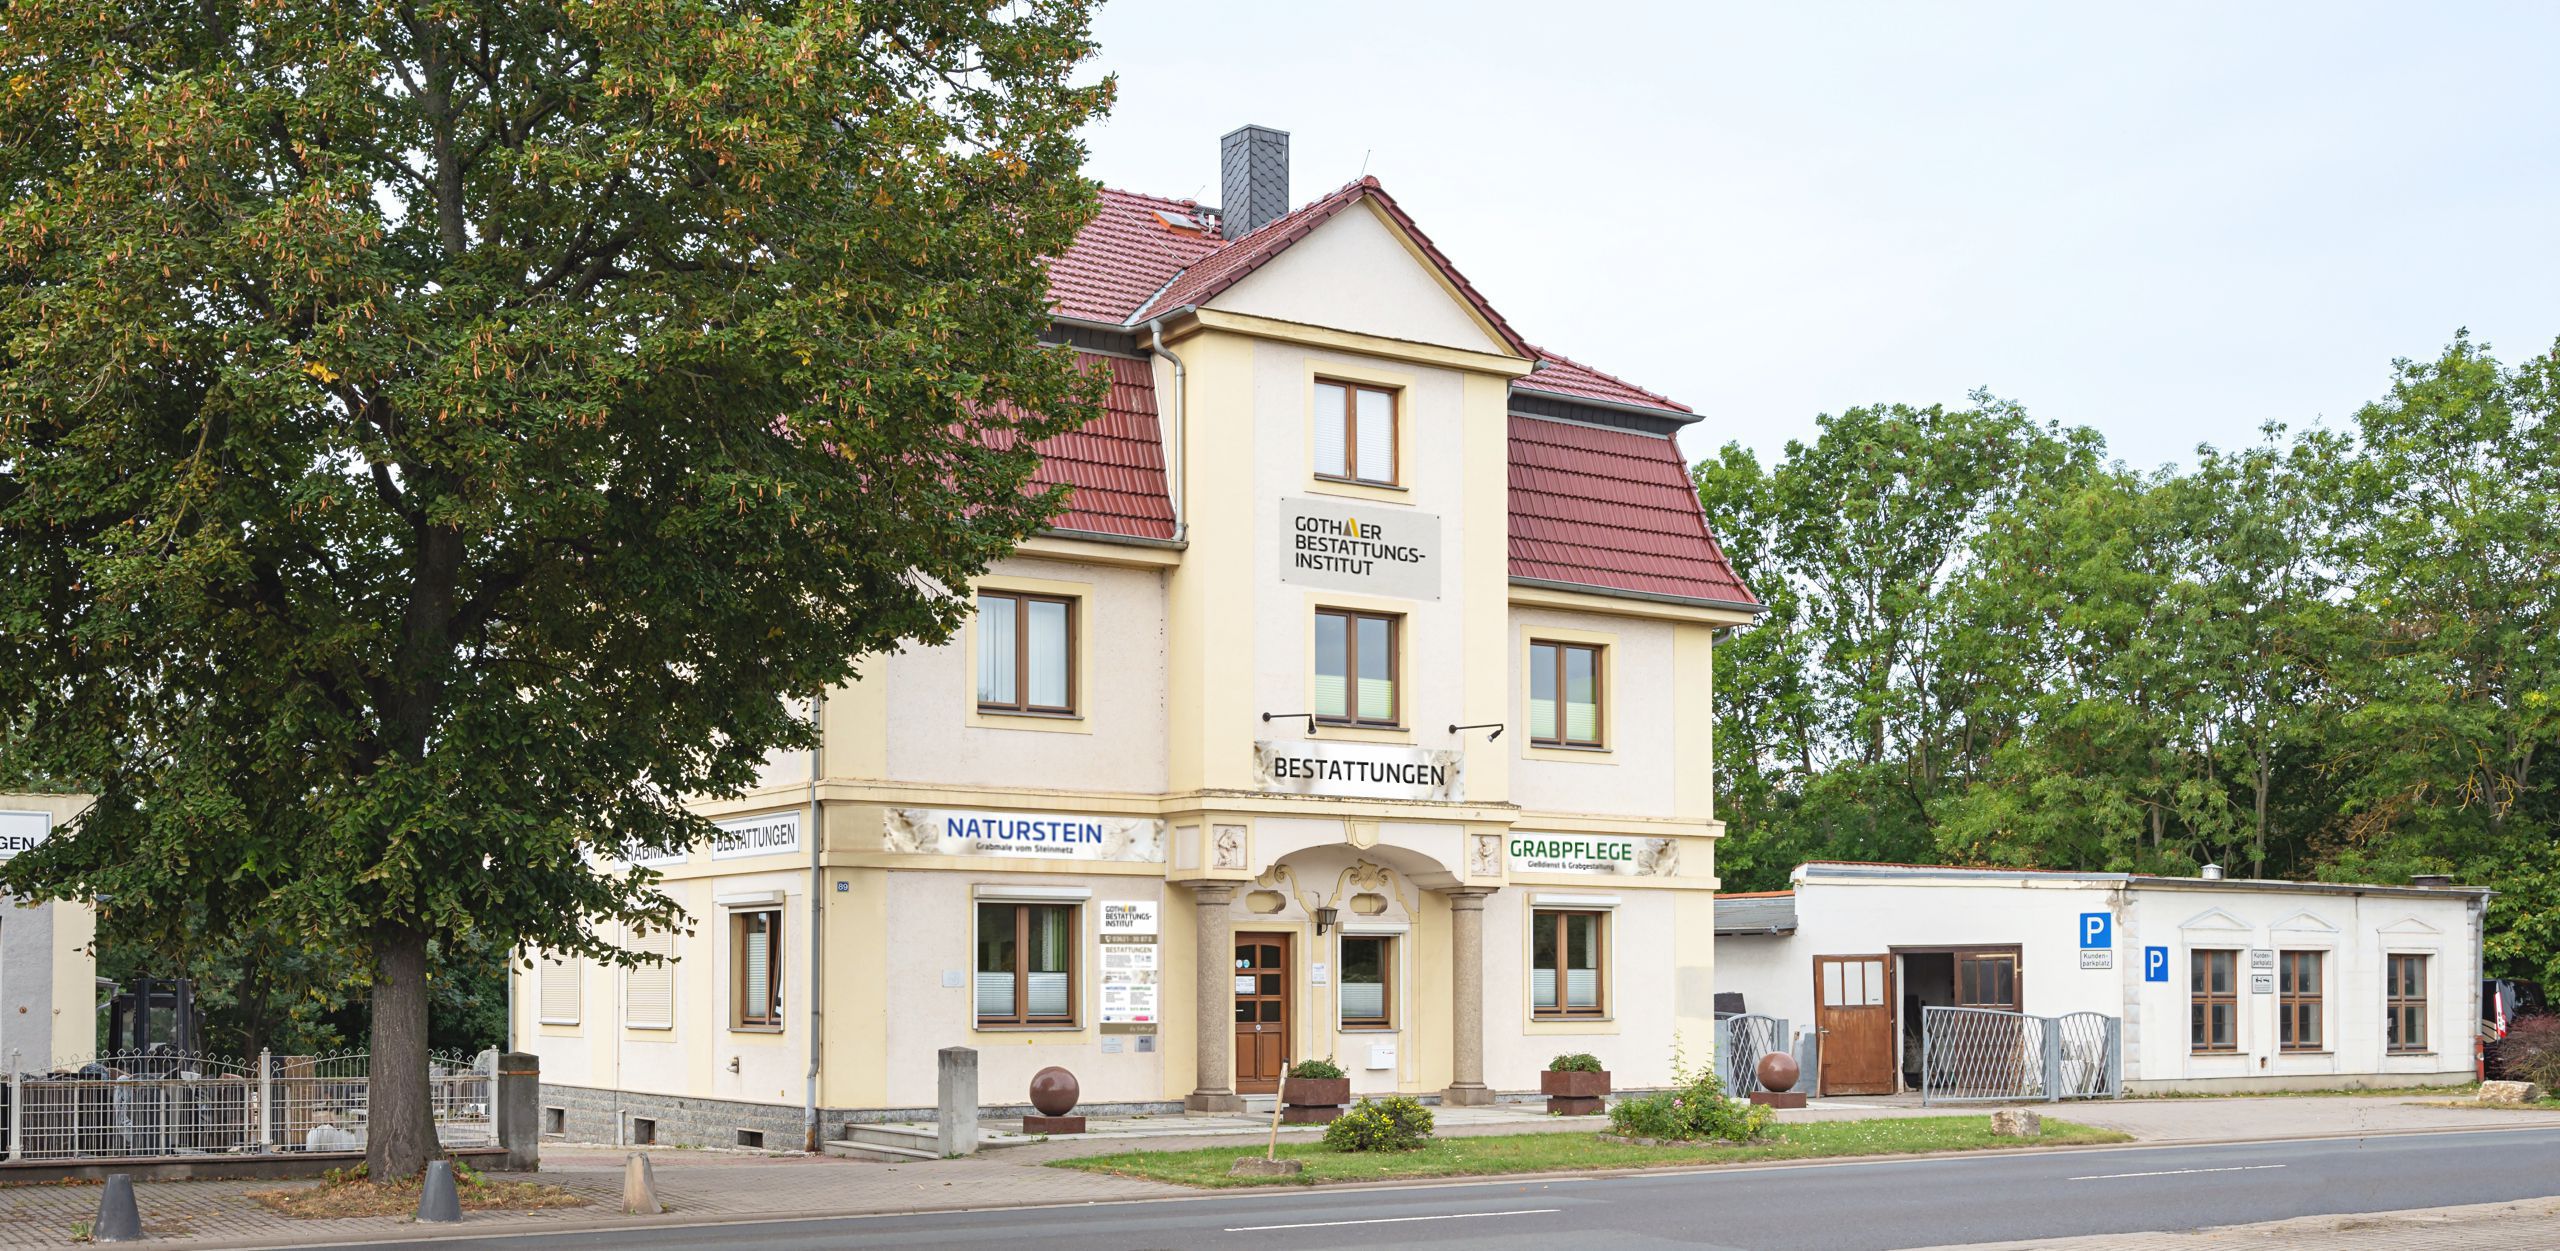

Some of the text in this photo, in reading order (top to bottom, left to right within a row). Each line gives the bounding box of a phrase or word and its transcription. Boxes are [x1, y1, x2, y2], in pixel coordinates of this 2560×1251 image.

[1295, 516, 1382, 540] GOTHAER
[1295, 534, 1426, 563] BESTATTUNGS-
[1295, 552, 1374, 576] INSTITUT
[1274, 757, 1445, 786] BESTATTUNGEN
[947, 818, 1103, 844] NATURSTEIN
[976, 842, 1073, 854] Grabmale vom Steinmetz
[1510, 839, 1632, 861] GRABPFLEGE
[1527, 860, 1560, 869] Gießdienst
[1568, 861, 1615, 872] Grabgestaltung
[838, 883, 848, 891] 89
[2087, 917, 2104, 944] P
[2150, 950, 2163, 978] P
